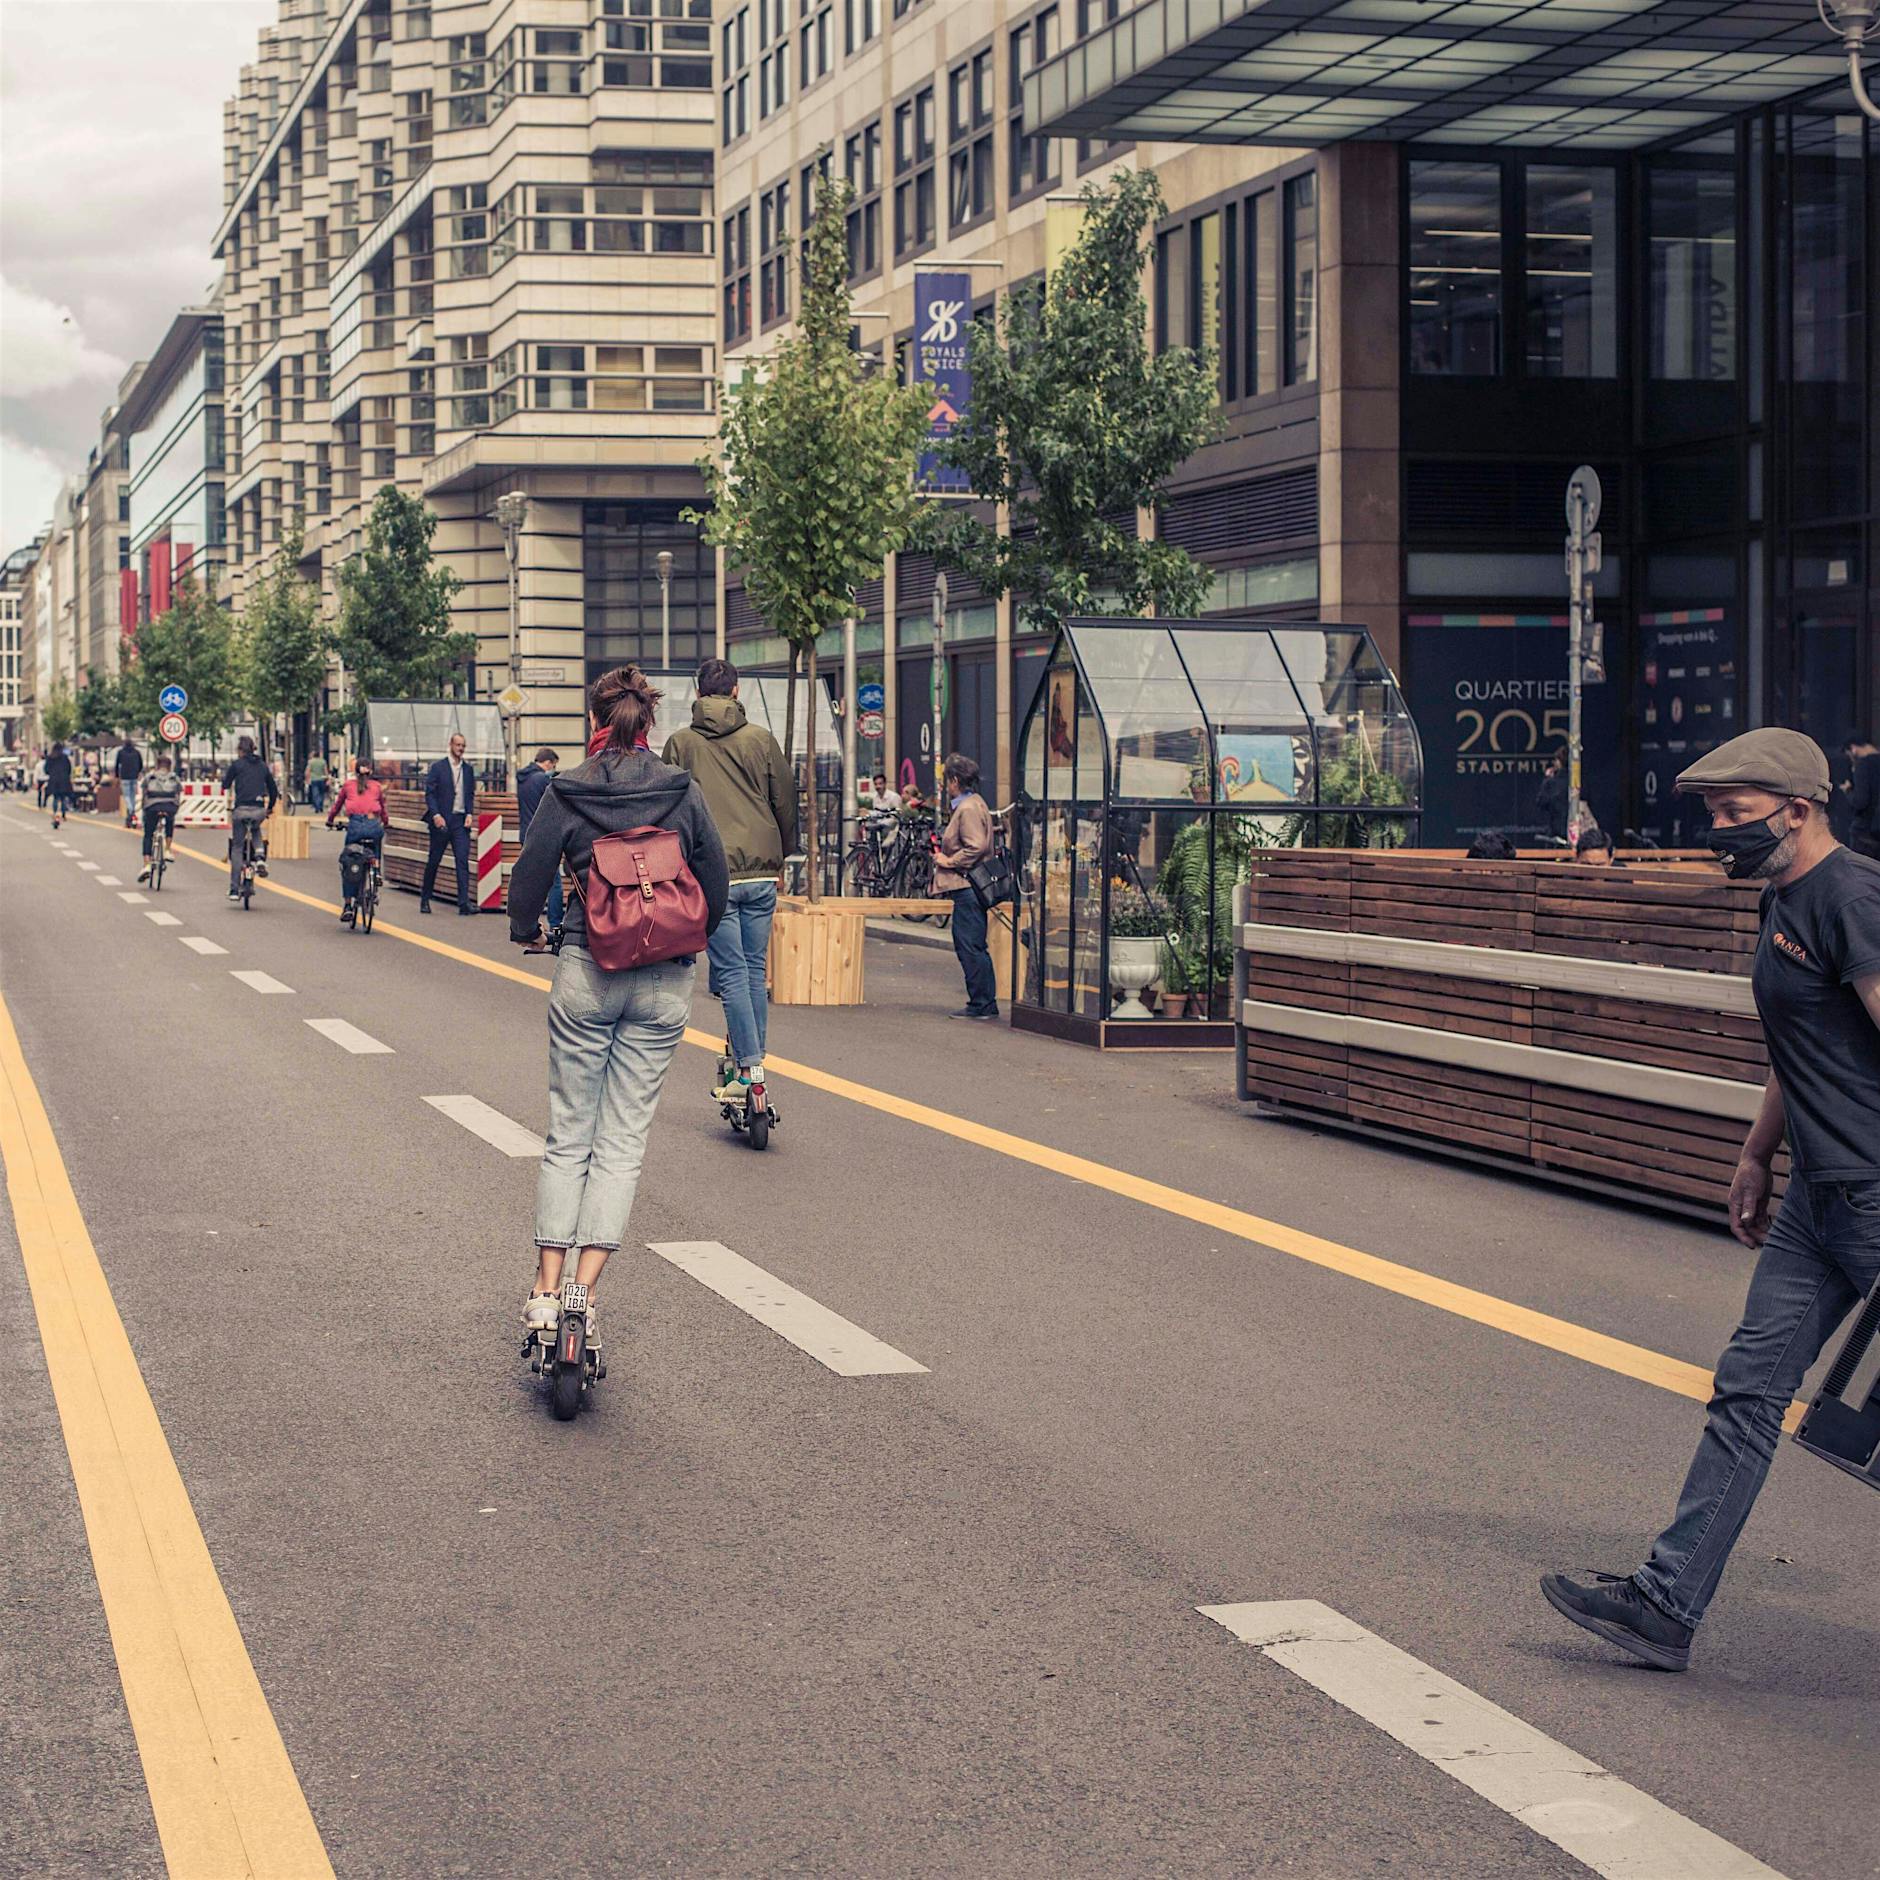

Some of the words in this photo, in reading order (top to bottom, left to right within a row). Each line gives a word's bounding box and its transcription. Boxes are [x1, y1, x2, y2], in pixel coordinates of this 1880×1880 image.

[1455, 680, 1571, 700] QUARTIER
[166, 721, 181, 733] 20
[1456, 709, 1571, 751] 205
[1456, 760, 1553, 773] STADTMIT
[568, 1285, 586, 1297] 020
